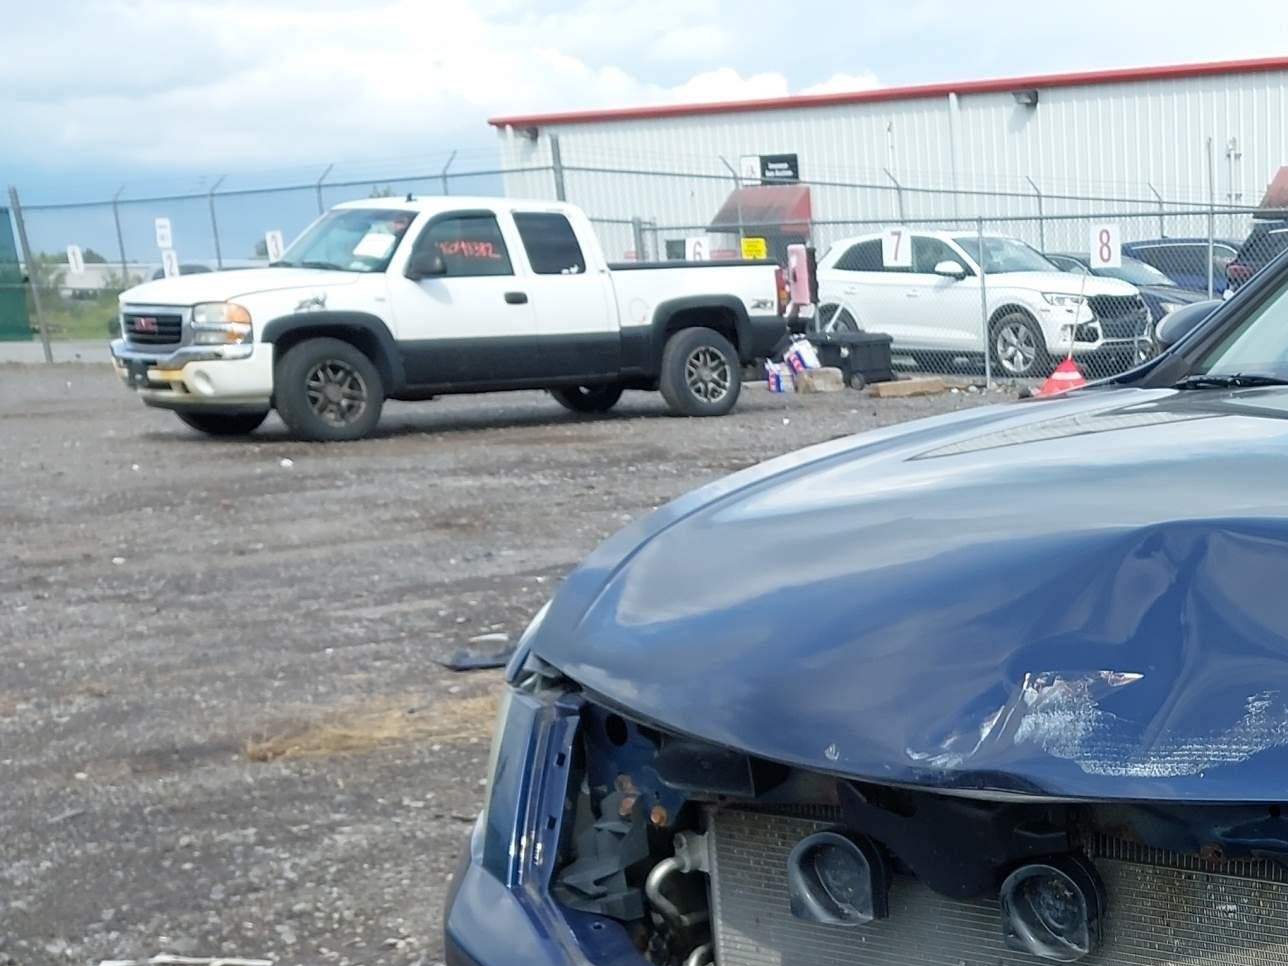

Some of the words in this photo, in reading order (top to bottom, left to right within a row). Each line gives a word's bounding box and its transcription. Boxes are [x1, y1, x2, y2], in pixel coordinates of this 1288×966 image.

[270, 233, 281, 260] 3
[890, 230, 902, 261] 7
[1099, 228, 1112, 264] 8
[166, 253, 176, 277] 2
